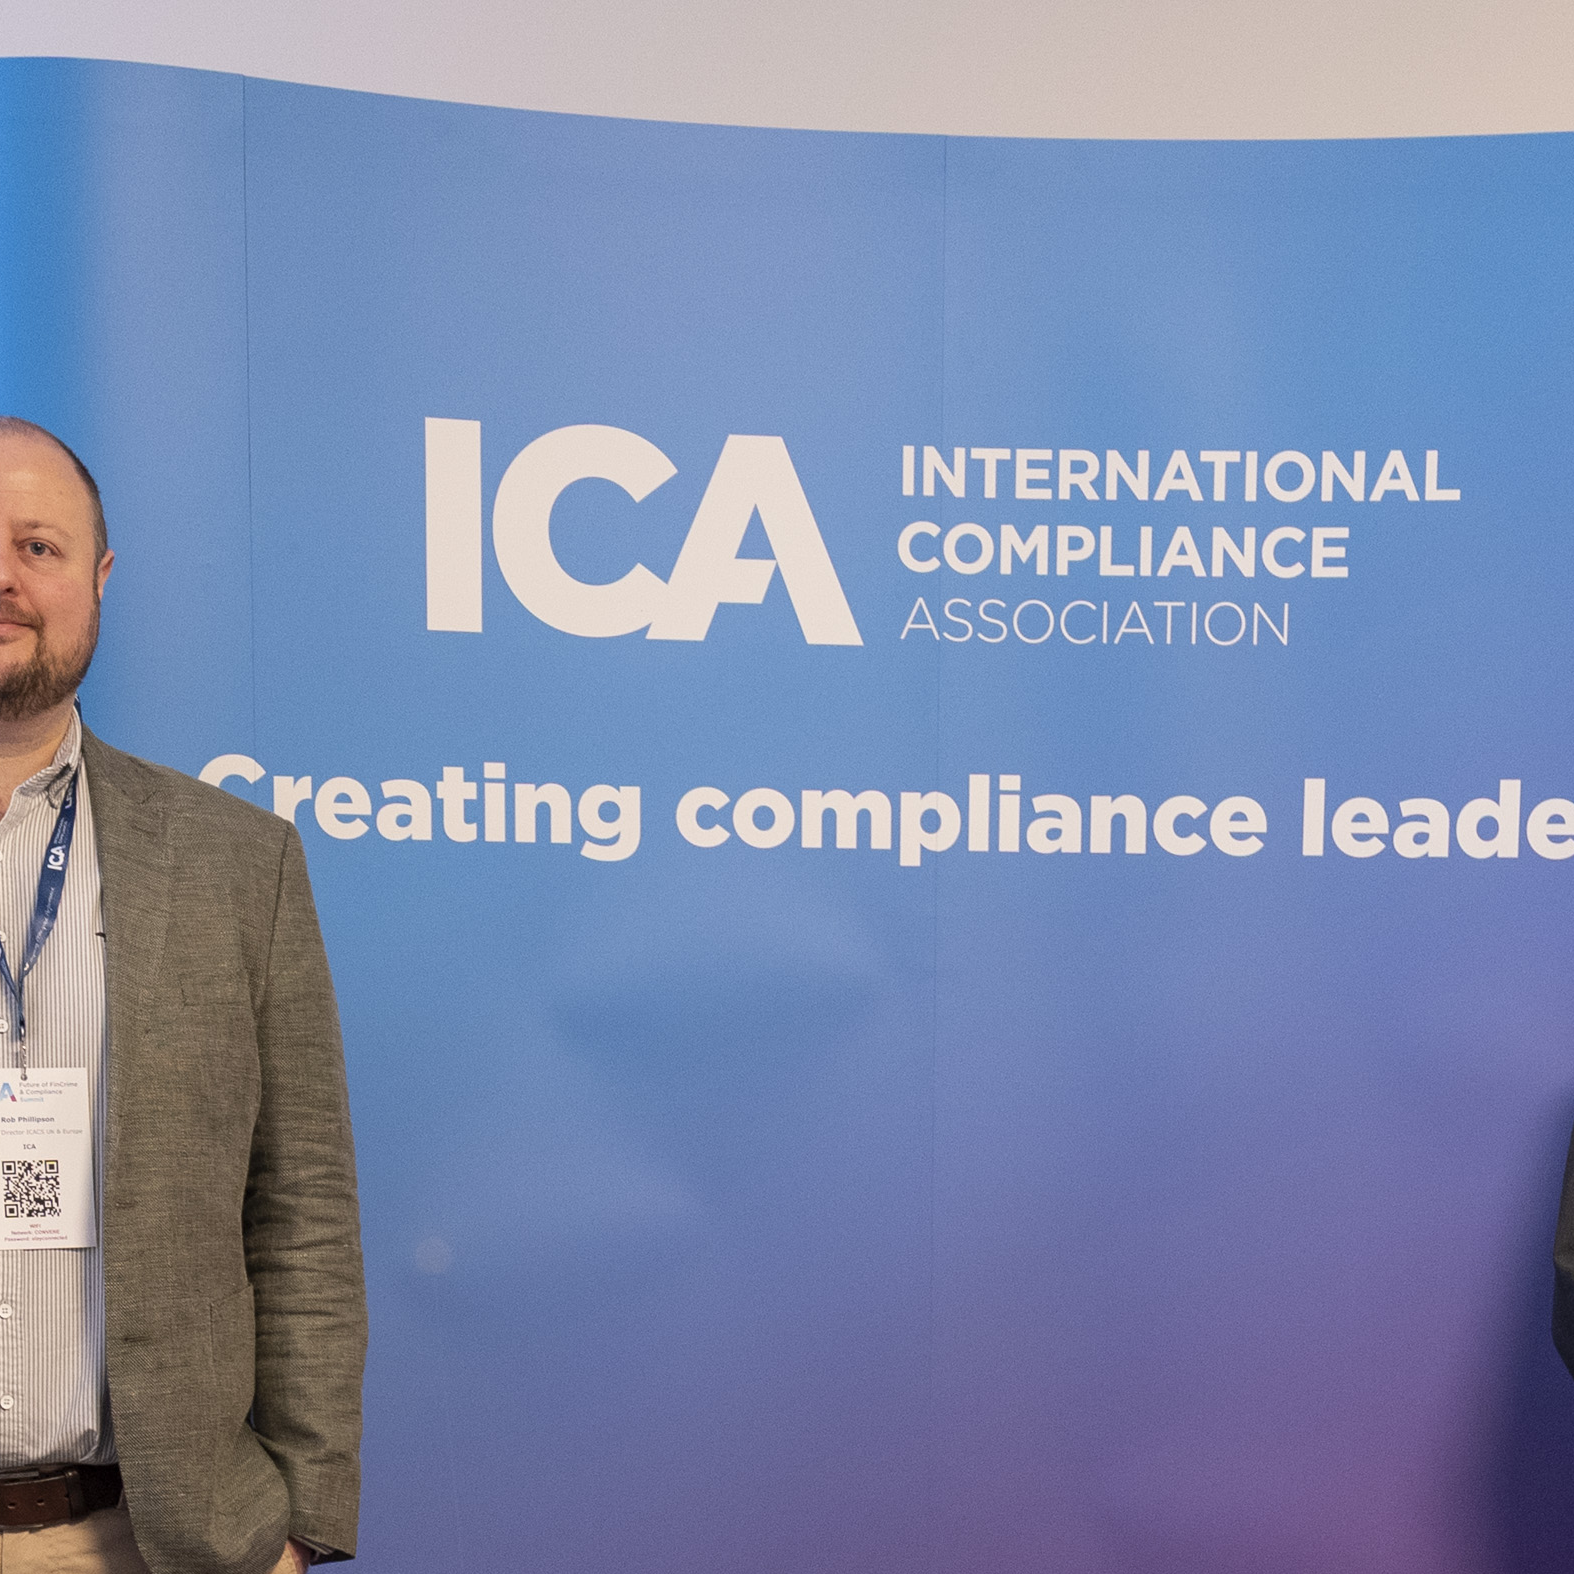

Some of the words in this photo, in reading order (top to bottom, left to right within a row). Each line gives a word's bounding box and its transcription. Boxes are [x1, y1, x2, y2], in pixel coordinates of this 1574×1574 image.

[901, 444, 1461, 504] INTERNATIONAL
[425, 416, 863, 646] ICA
[897, 519, 1350, 580] COMPLIANCE
[900, 595, 1290, 648] ASSOCIATION
[676, 774, 1268, 867] compliance
[47, 845, 67, 871] ICA
